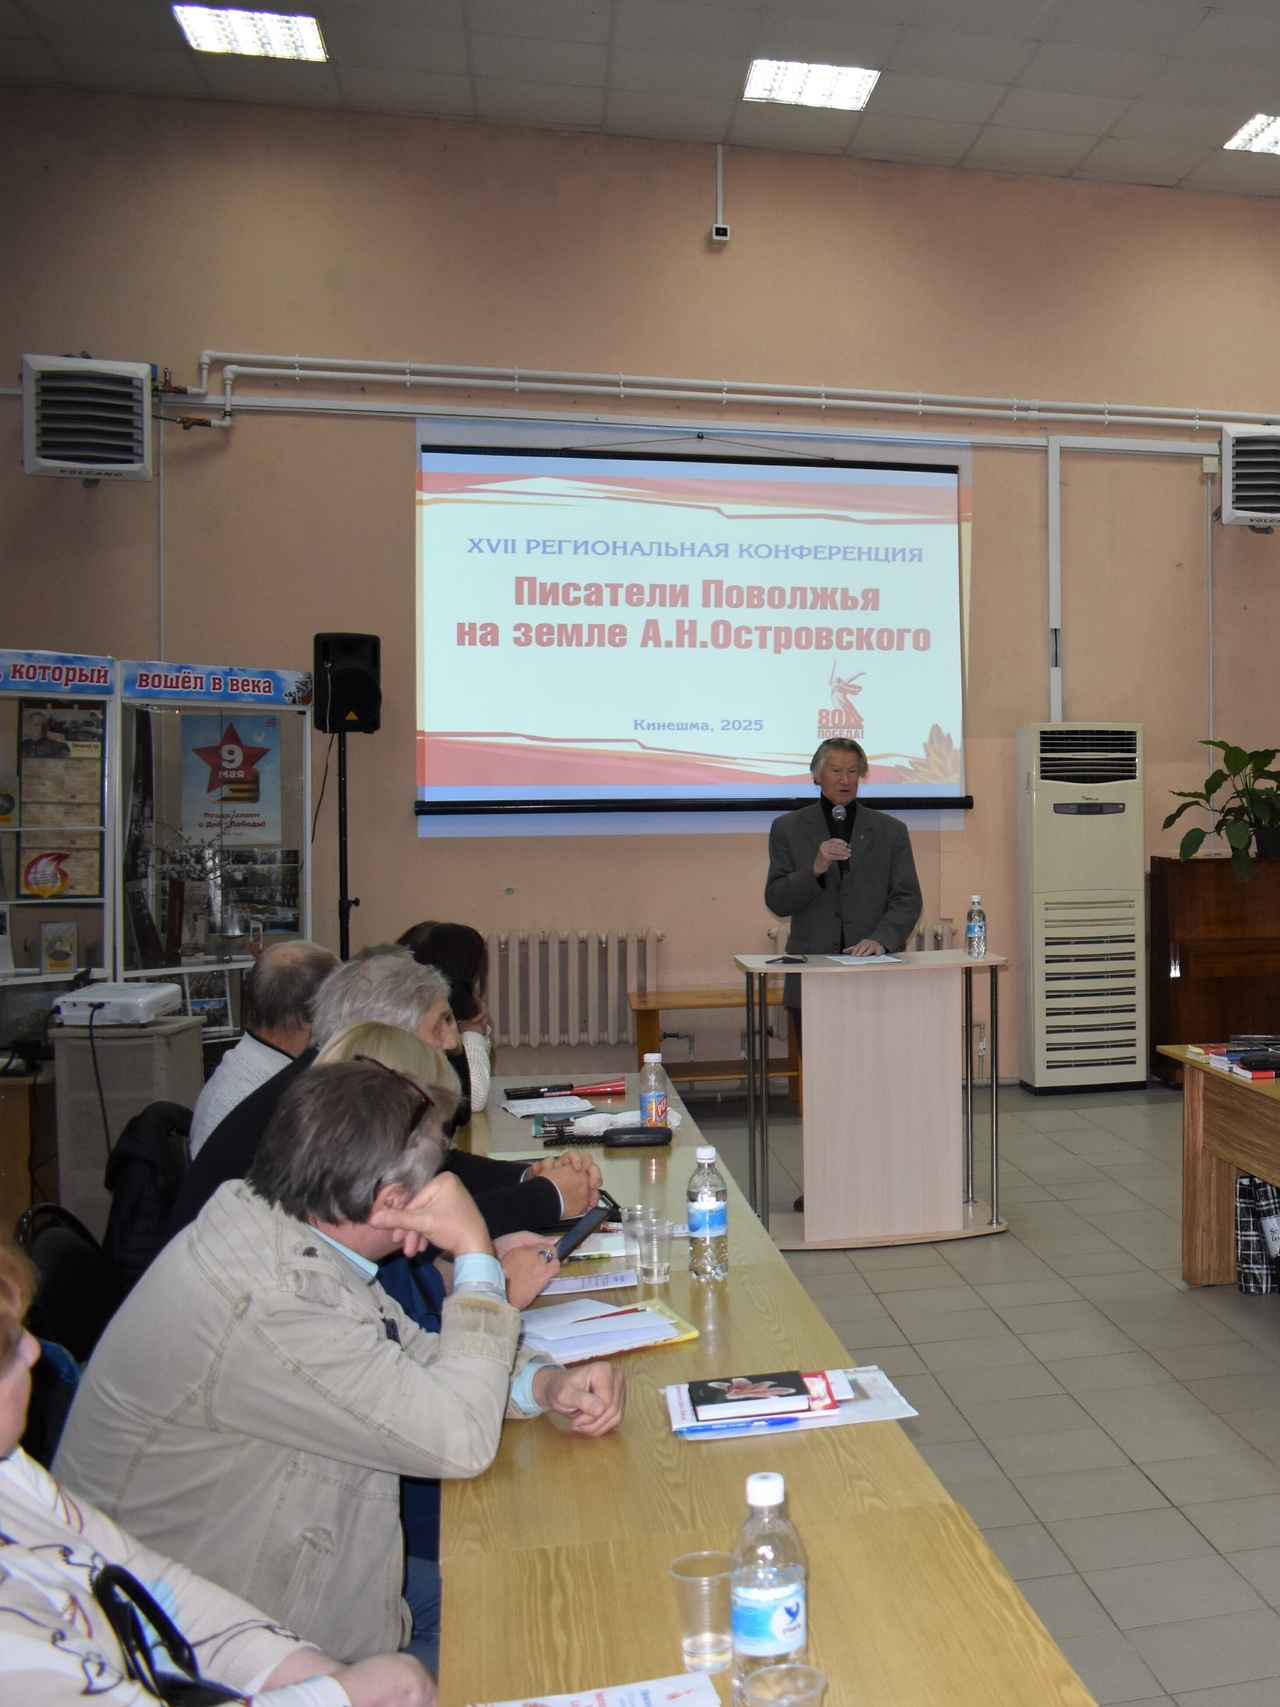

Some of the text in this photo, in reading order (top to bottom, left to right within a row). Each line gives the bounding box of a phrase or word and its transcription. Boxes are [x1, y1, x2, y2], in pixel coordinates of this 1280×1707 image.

[467, 538, 924, 564] XVII РЕГИОНАЛЬНАЯ КОНФЕРЕНЦИЯ
[514, 576, 880, 611] Писатели Поволжья
[456, 619, 931, 654] на земле А.Н.Островского
[10, 663, 109, 687] который
[138, 671, 273, 694] вошёл в века
[633, 719, 764, 733] Кинешма, 2025
[818, 708, 846, 729] 80
[817, 728, 864, 740] ПОБЕДА!
[221, 743, 243, 770] 9
[218, 769, 245, 779] мая
[229, 820, 266, 829] Победы!
